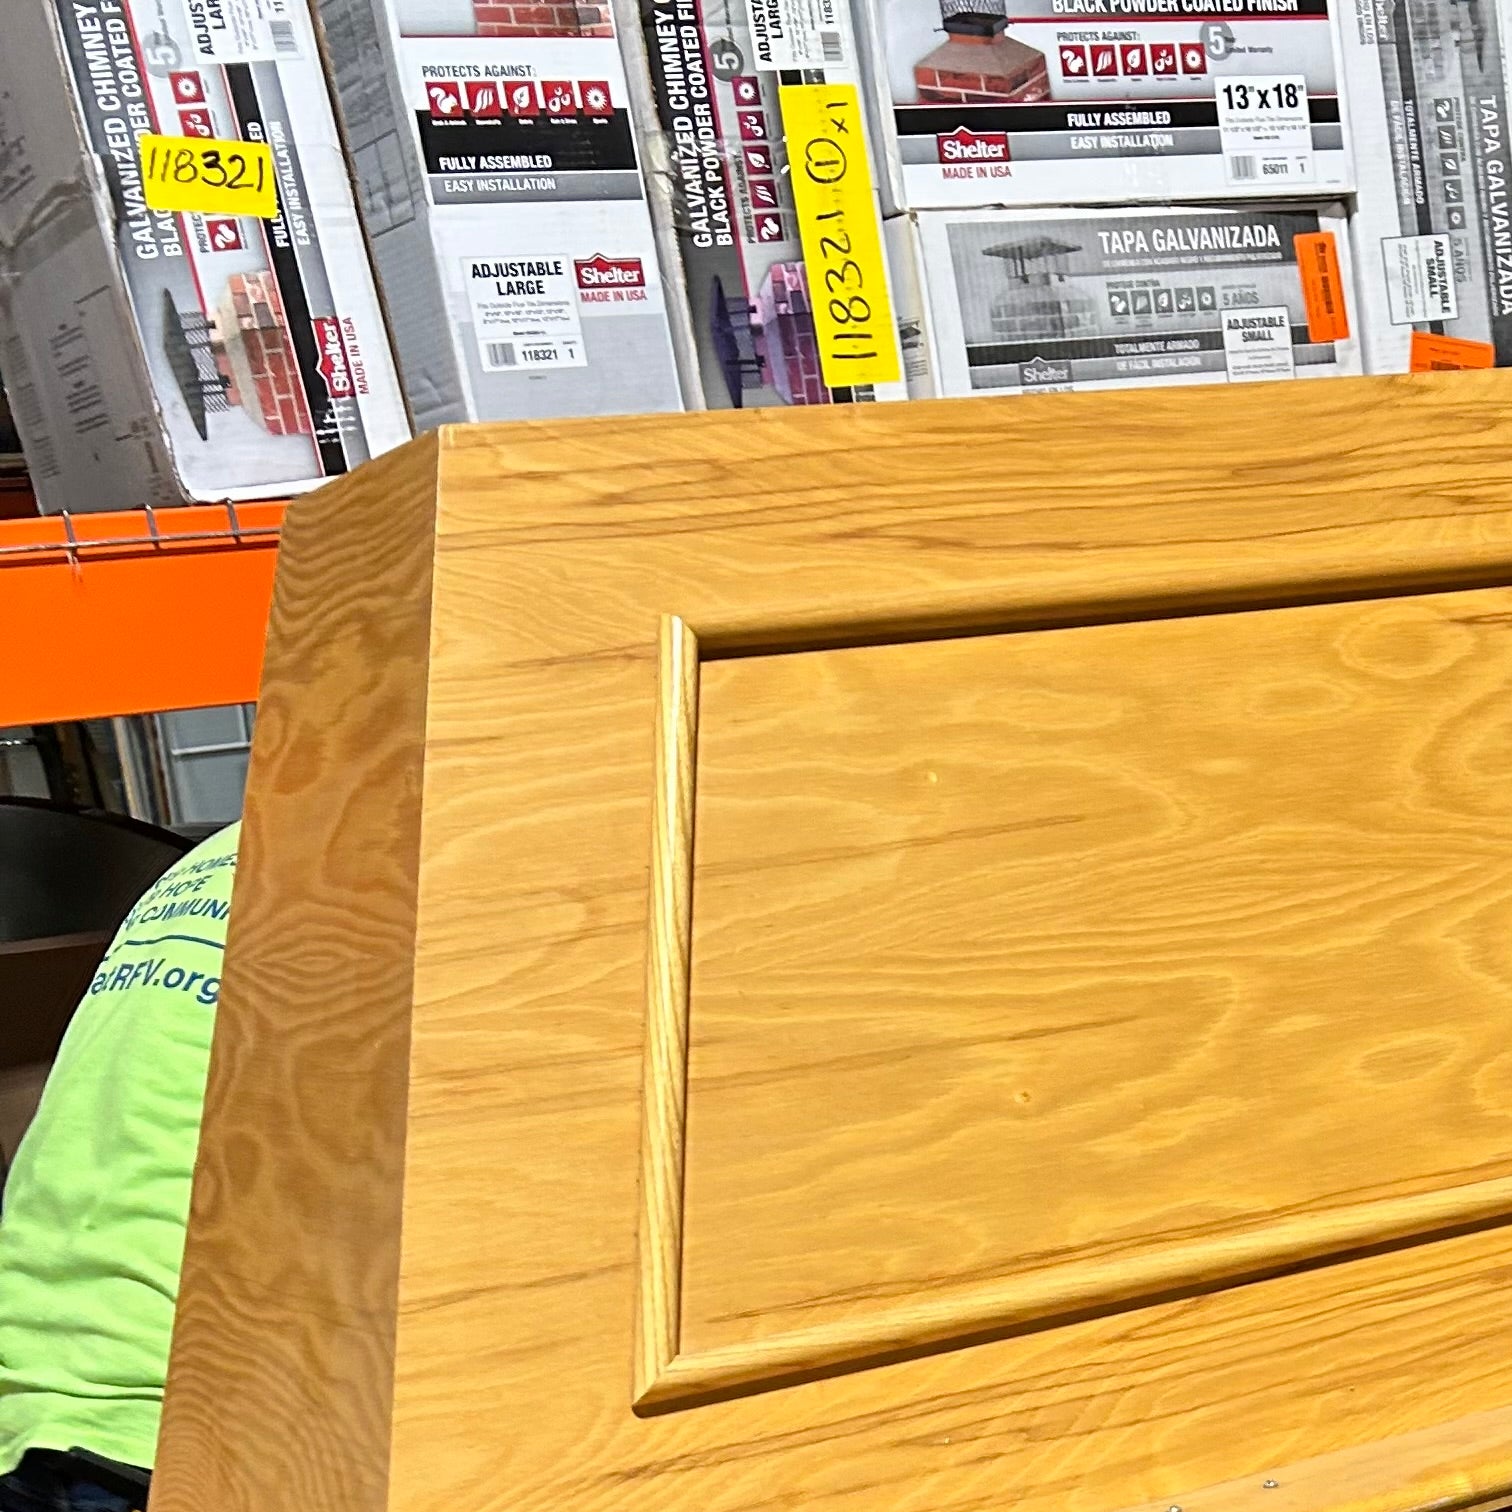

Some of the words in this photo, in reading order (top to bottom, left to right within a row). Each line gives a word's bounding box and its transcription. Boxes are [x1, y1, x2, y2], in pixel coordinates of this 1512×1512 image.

[207, 0, 226, 30] LAR
[765, 0, 784, 40] LARG
[1053, 0, 1107, 14] BLACK
[1109, 0, 1180, 13] POWDER
[1184, 0, 1245, 12] COATED
[1249, 0, 1299, 12] FINISH
[751, 0, 773, 62] ADJUSTA
[1056, 31, 1100, 42] PROTECTS
[1207, 26, 1226, 55] 5
[73, 2, 122, 111] CHIMNEY
[105, 18, 143, 98] COATED
[422, 64, 481, 78] PROTECTS
[653, 9, 690, 111] CHIMNEY
[679, 25, 708, 98] COATED
[713, 51, 740, 71] 5
[1066, 113, 1101, 127] FULLY
[1103, 111, 1171, 126] ASSEMBLED
[1479, 95, 1501, 154] TAPA
[692, 102, 723, 183] POWDER
[943, 139, 1005, 160] Shelter
[1070, 136, 1099, 149] EASY
[1100, 134, 1174, 149] INSTALLATION
[148, 147, 263, 193] 118321
[269, 120, 301, 211] INSTALLATION
[438, 155, 477, 171] FULLY
[479, 153, 552, 170] ASSEMBLED
[942, 167, 974, 180] MADE
[976, 166, 989, 179] IN
[991, 165, 1013, 178] USA
[104, 117, 159, 260] GALVANIZED
[444, 178, 475, 193] EASY
[477, 176, 556, 192] INSTALLATION
[672, 115, 713, 249] GALVANIZED
[269, 201, 290, 247] FULL
[291, 211, 311, 246] EASY
[708, 184, 734, 247] BLACK
[152, 208, 182, 257] BLAC
[1097, 229, 1150, 255] TAPA
[1151, 223, 1281, 252] GALVANIZADA
[471, 260, 564, 279] ADJUSTABLE
[580, 266, 641, 286] Shelter
[816, 210, 878, 359] 118321
[1425, 257, 1440, 299] SMALL
[1433, 239, 1451, 314] ADJUSTABLE
[496, 279, 546, 297] LARGE
[580, 291, 611, 304] MADE
[612, 291, 625, 303] IN
[626, 290, 648, 302] USA
[1226, 315, 1286, 331] ADJUSTABLE
[1241, 329, 1274, 343] SMALL
[522, 349, 559, 362] 118321
[568, 348, 575, 360] 1
[1023, 366, 1070, 384] Shelter
[139, 898, 230, 924] COMMUN
